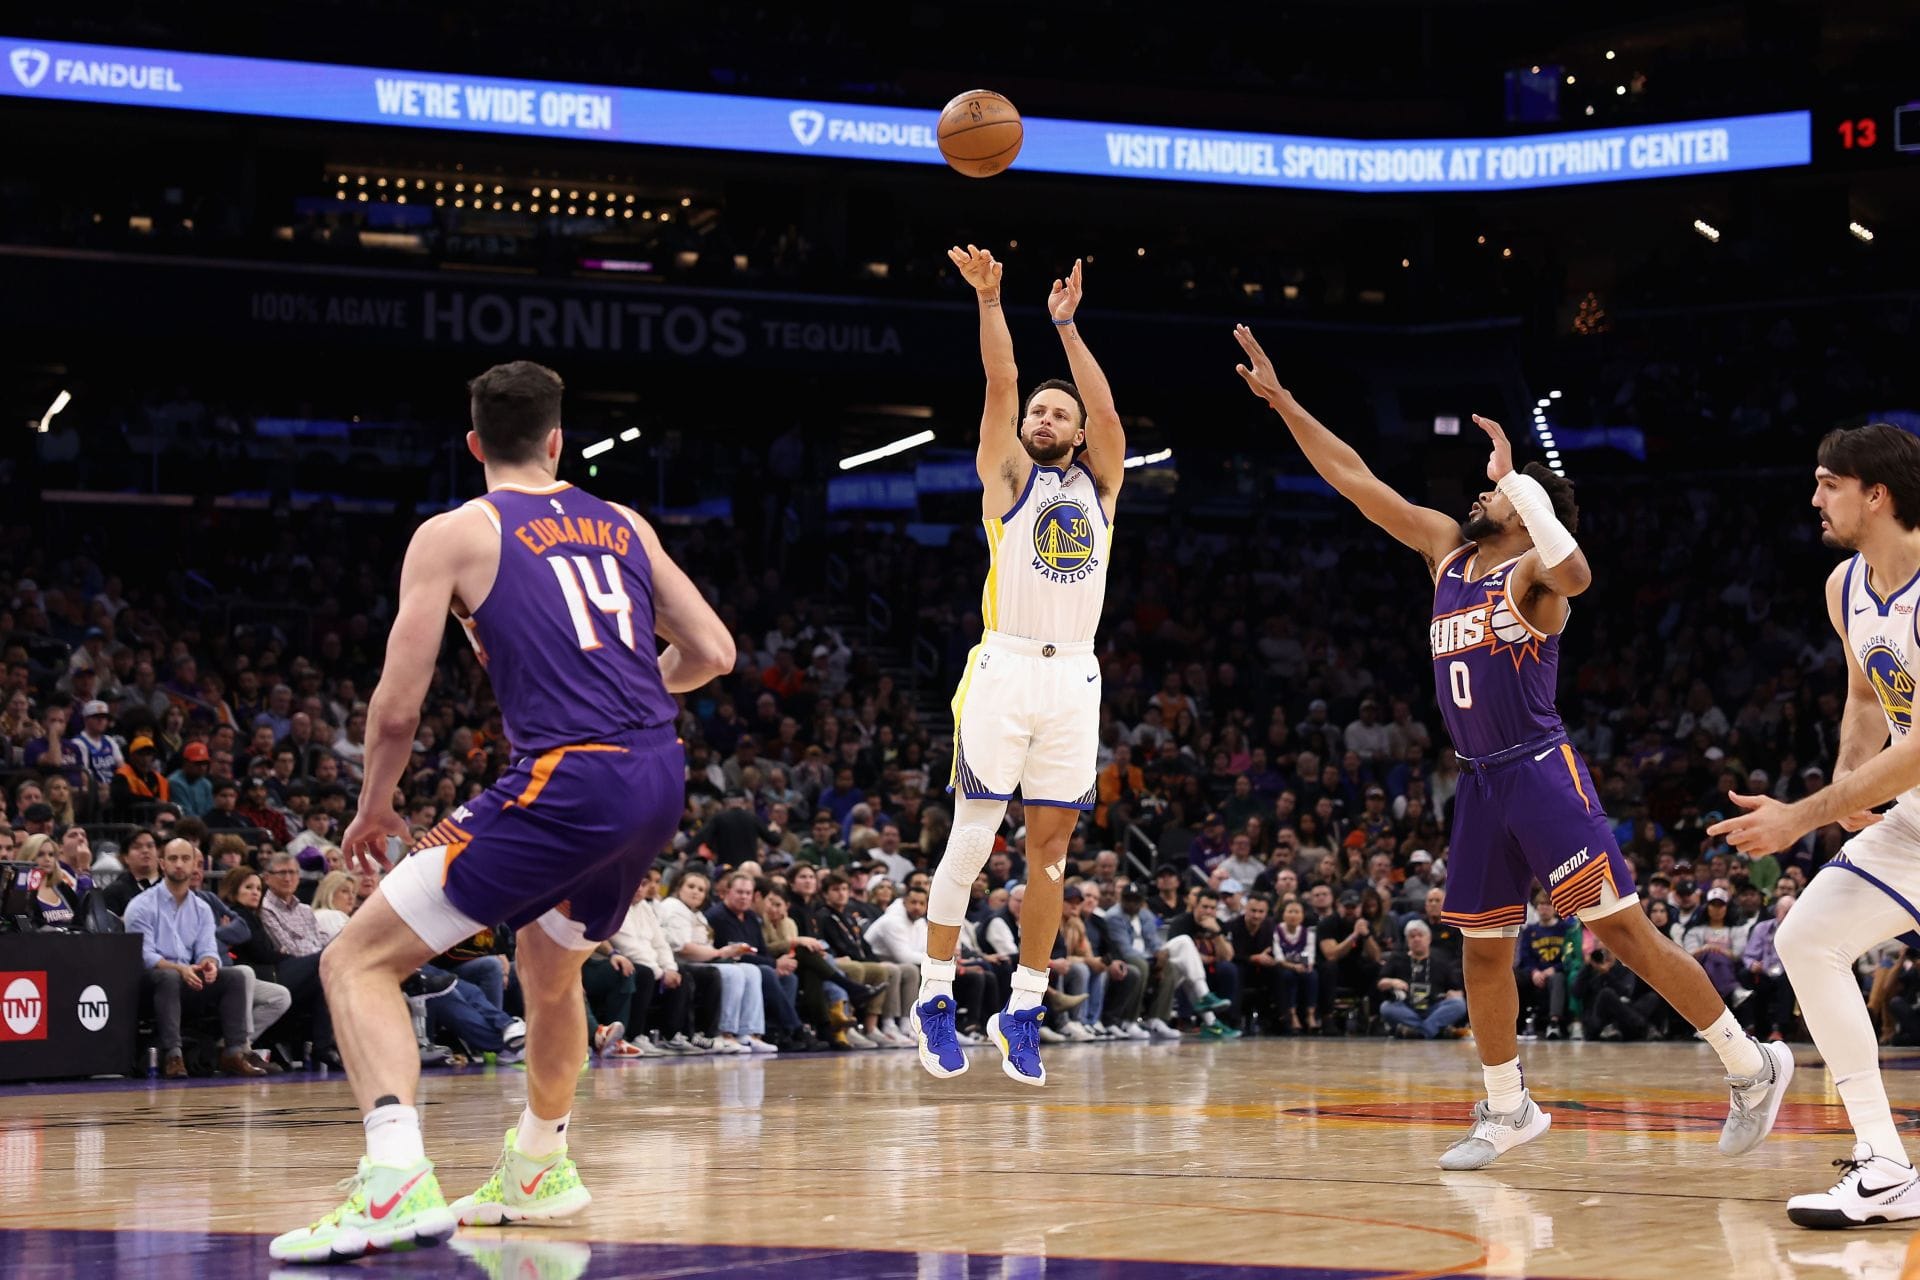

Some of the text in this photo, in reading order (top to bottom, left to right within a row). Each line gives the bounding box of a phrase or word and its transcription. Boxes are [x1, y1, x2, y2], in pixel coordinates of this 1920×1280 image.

[55, 58, 183, 92] FANDUEL
[375, 78, 612, 130] WE'RE WIDE OPEN
[828, 118, 939, 148] FANDUEL
[1836, 117, 1878, 150] 13
[1106, 128, 1729, 182] VISIT FANDUEL SPORTSBOOK AT FOOTPRINT CENTER
[250, 290, 902, 357] 100% AGAVE HORNITOS TEQUILA
[515, 516, 631, 556] EUBANKS
[1070, 518, 1087, 538] 30
[1031, 556, 1099, 584] WARRIORS
[546, 554, 637, 651] 14
[1449, 660, 1472, 709] 0
[1889, 669, 1912, 693] 20
[1549, 846, 1590, 887] PHOENIX
[3, 997, 42, 1019] TNT
[78, 1001, 109, 1018] TNT
